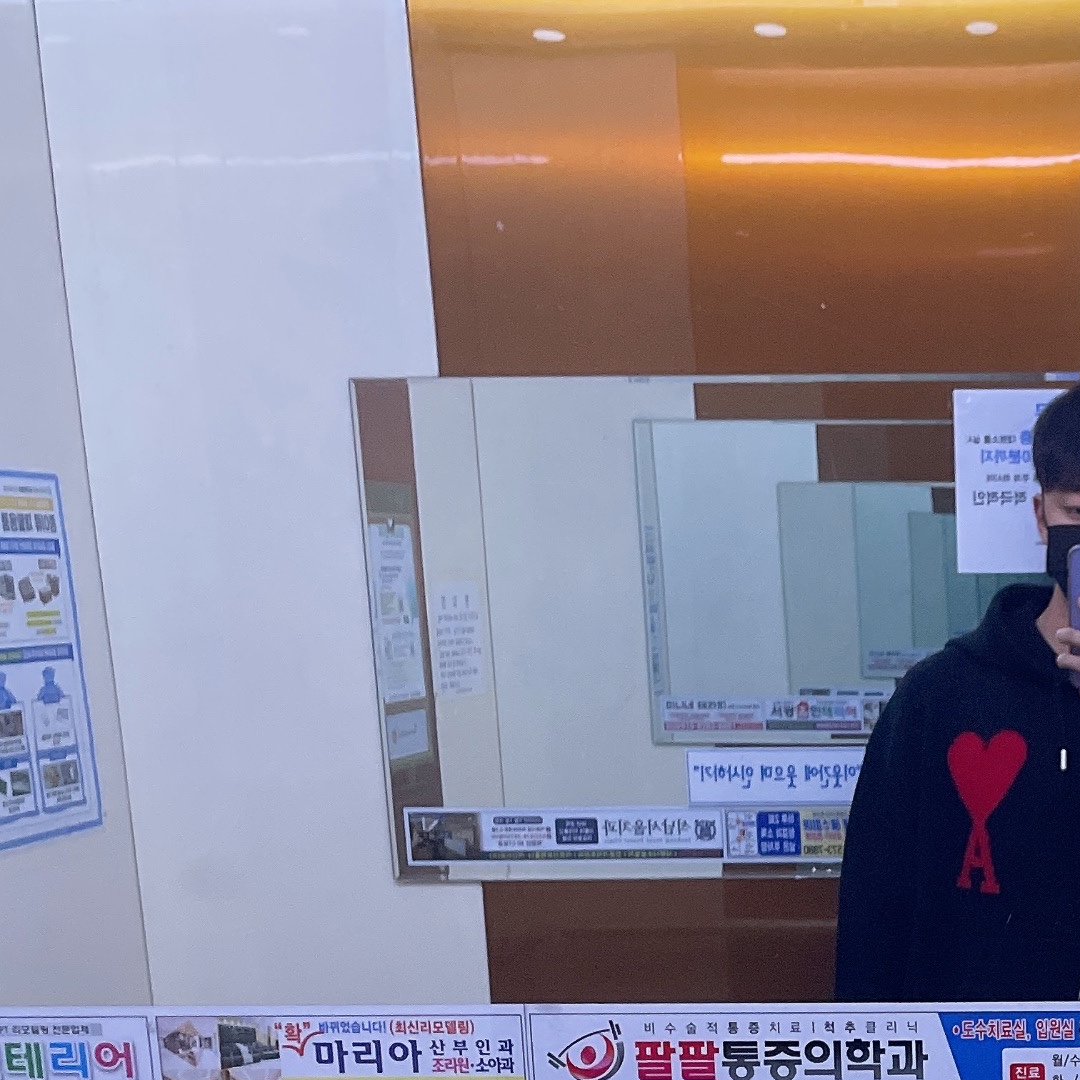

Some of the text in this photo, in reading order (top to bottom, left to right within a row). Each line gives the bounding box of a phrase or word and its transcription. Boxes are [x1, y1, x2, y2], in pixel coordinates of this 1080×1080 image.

[1036, 1018, 1075, 1040] 입원실
[312, 1039, 514, 1073] 마리아 산부인과
[1015, 1066, 1040, 1079] 진료
